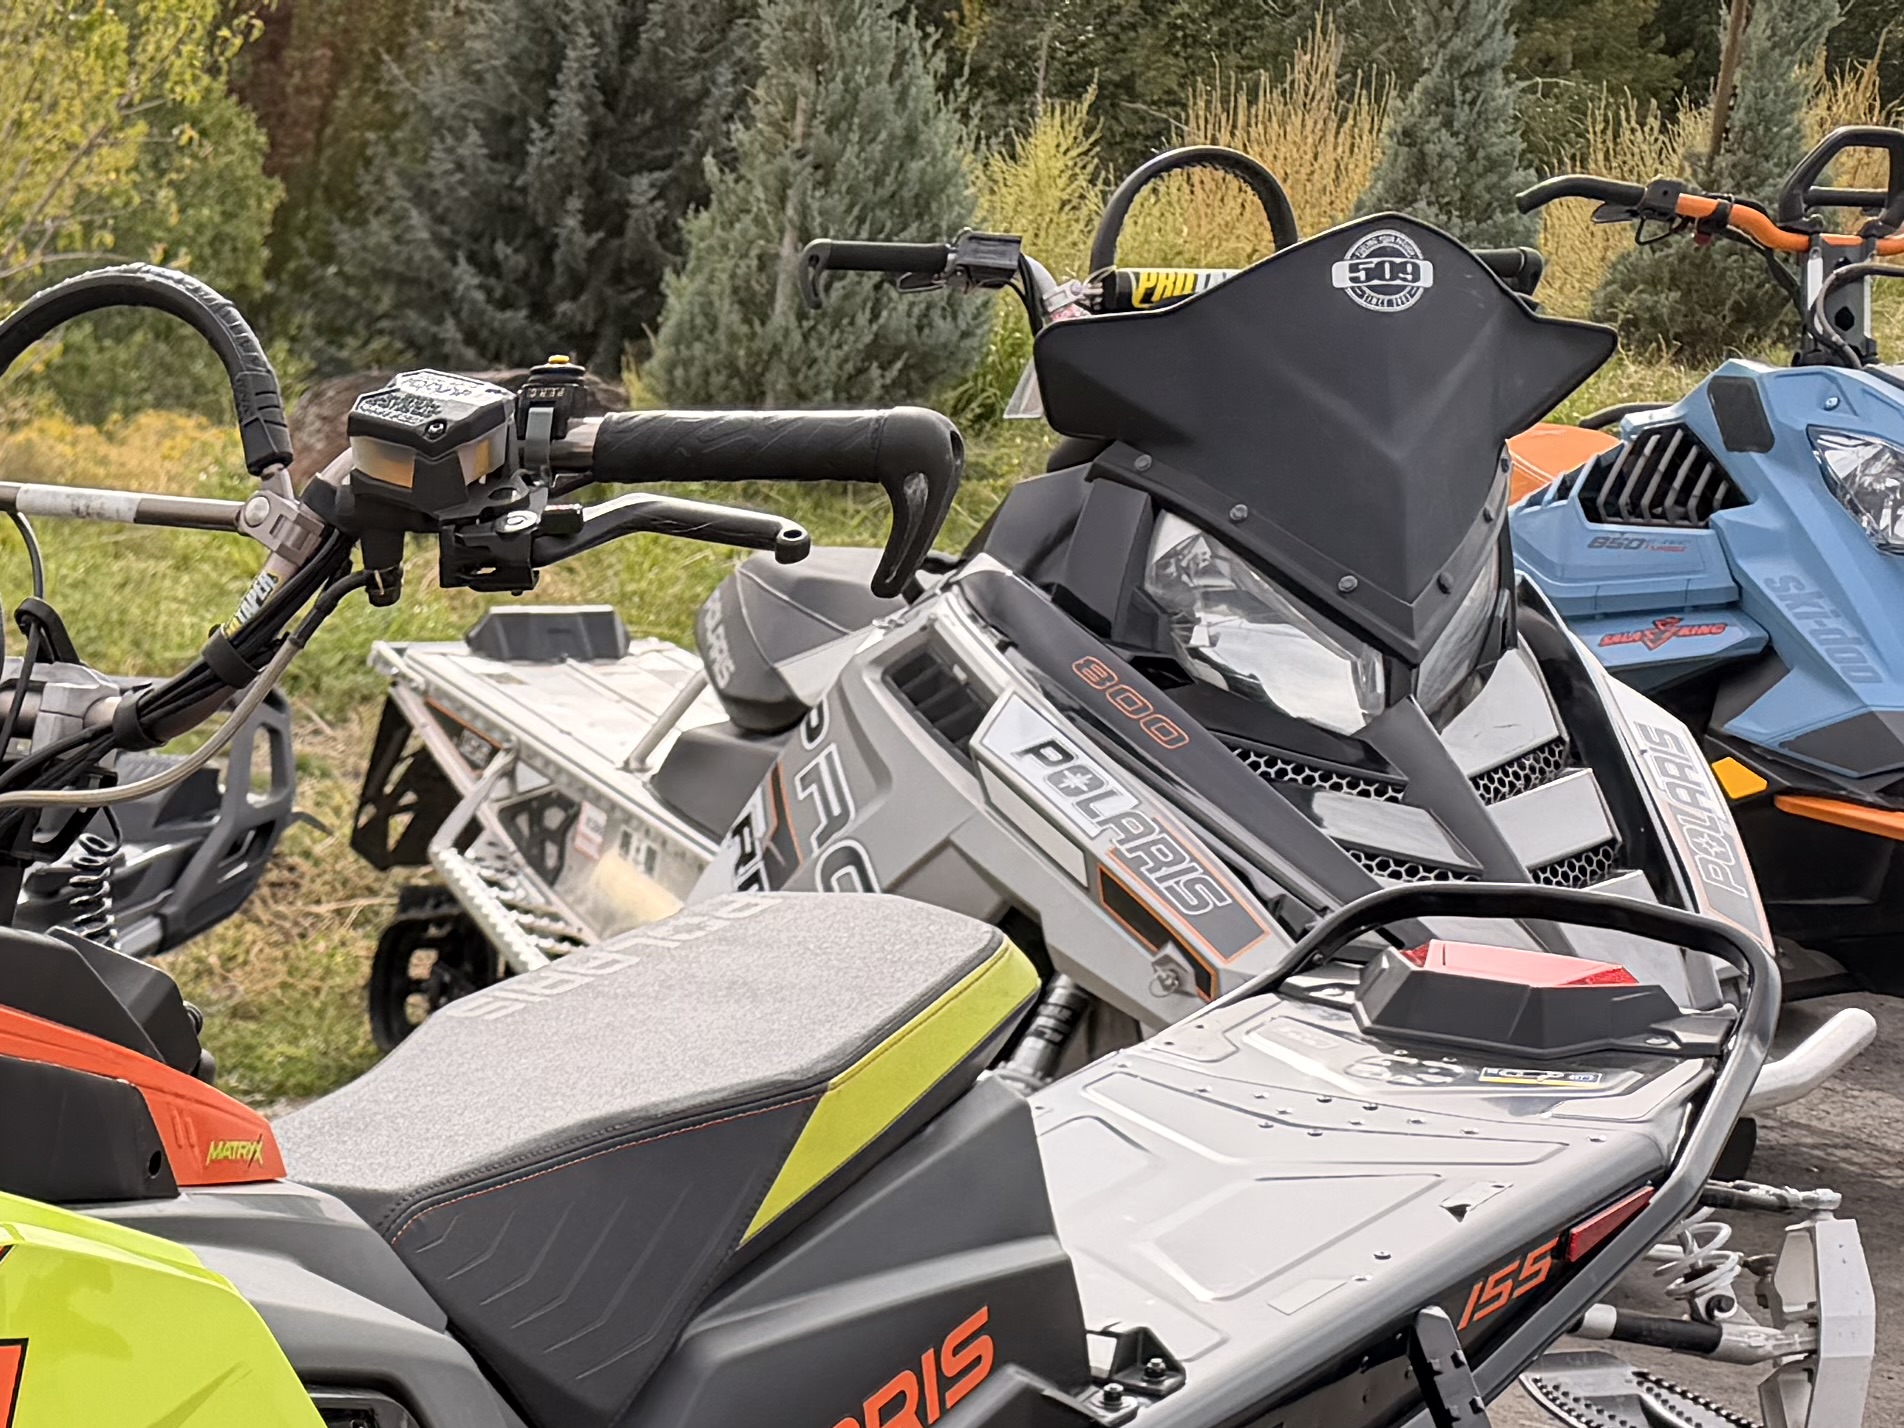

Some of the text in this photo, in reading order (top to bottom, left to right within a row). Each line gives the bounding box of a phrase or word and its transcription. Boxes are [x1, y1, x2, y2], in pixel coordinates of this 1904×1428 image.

[1348, 260, 1421, 284] 509
[1587, 536, 1646, 550] 850
[1072, 656, 1189, 749] 800
[1012, 738, 1233, 915] POLARIS
[1633, 720, 1749, 898] POLARIS
[1458, 1237, 1560, 1330] 155
